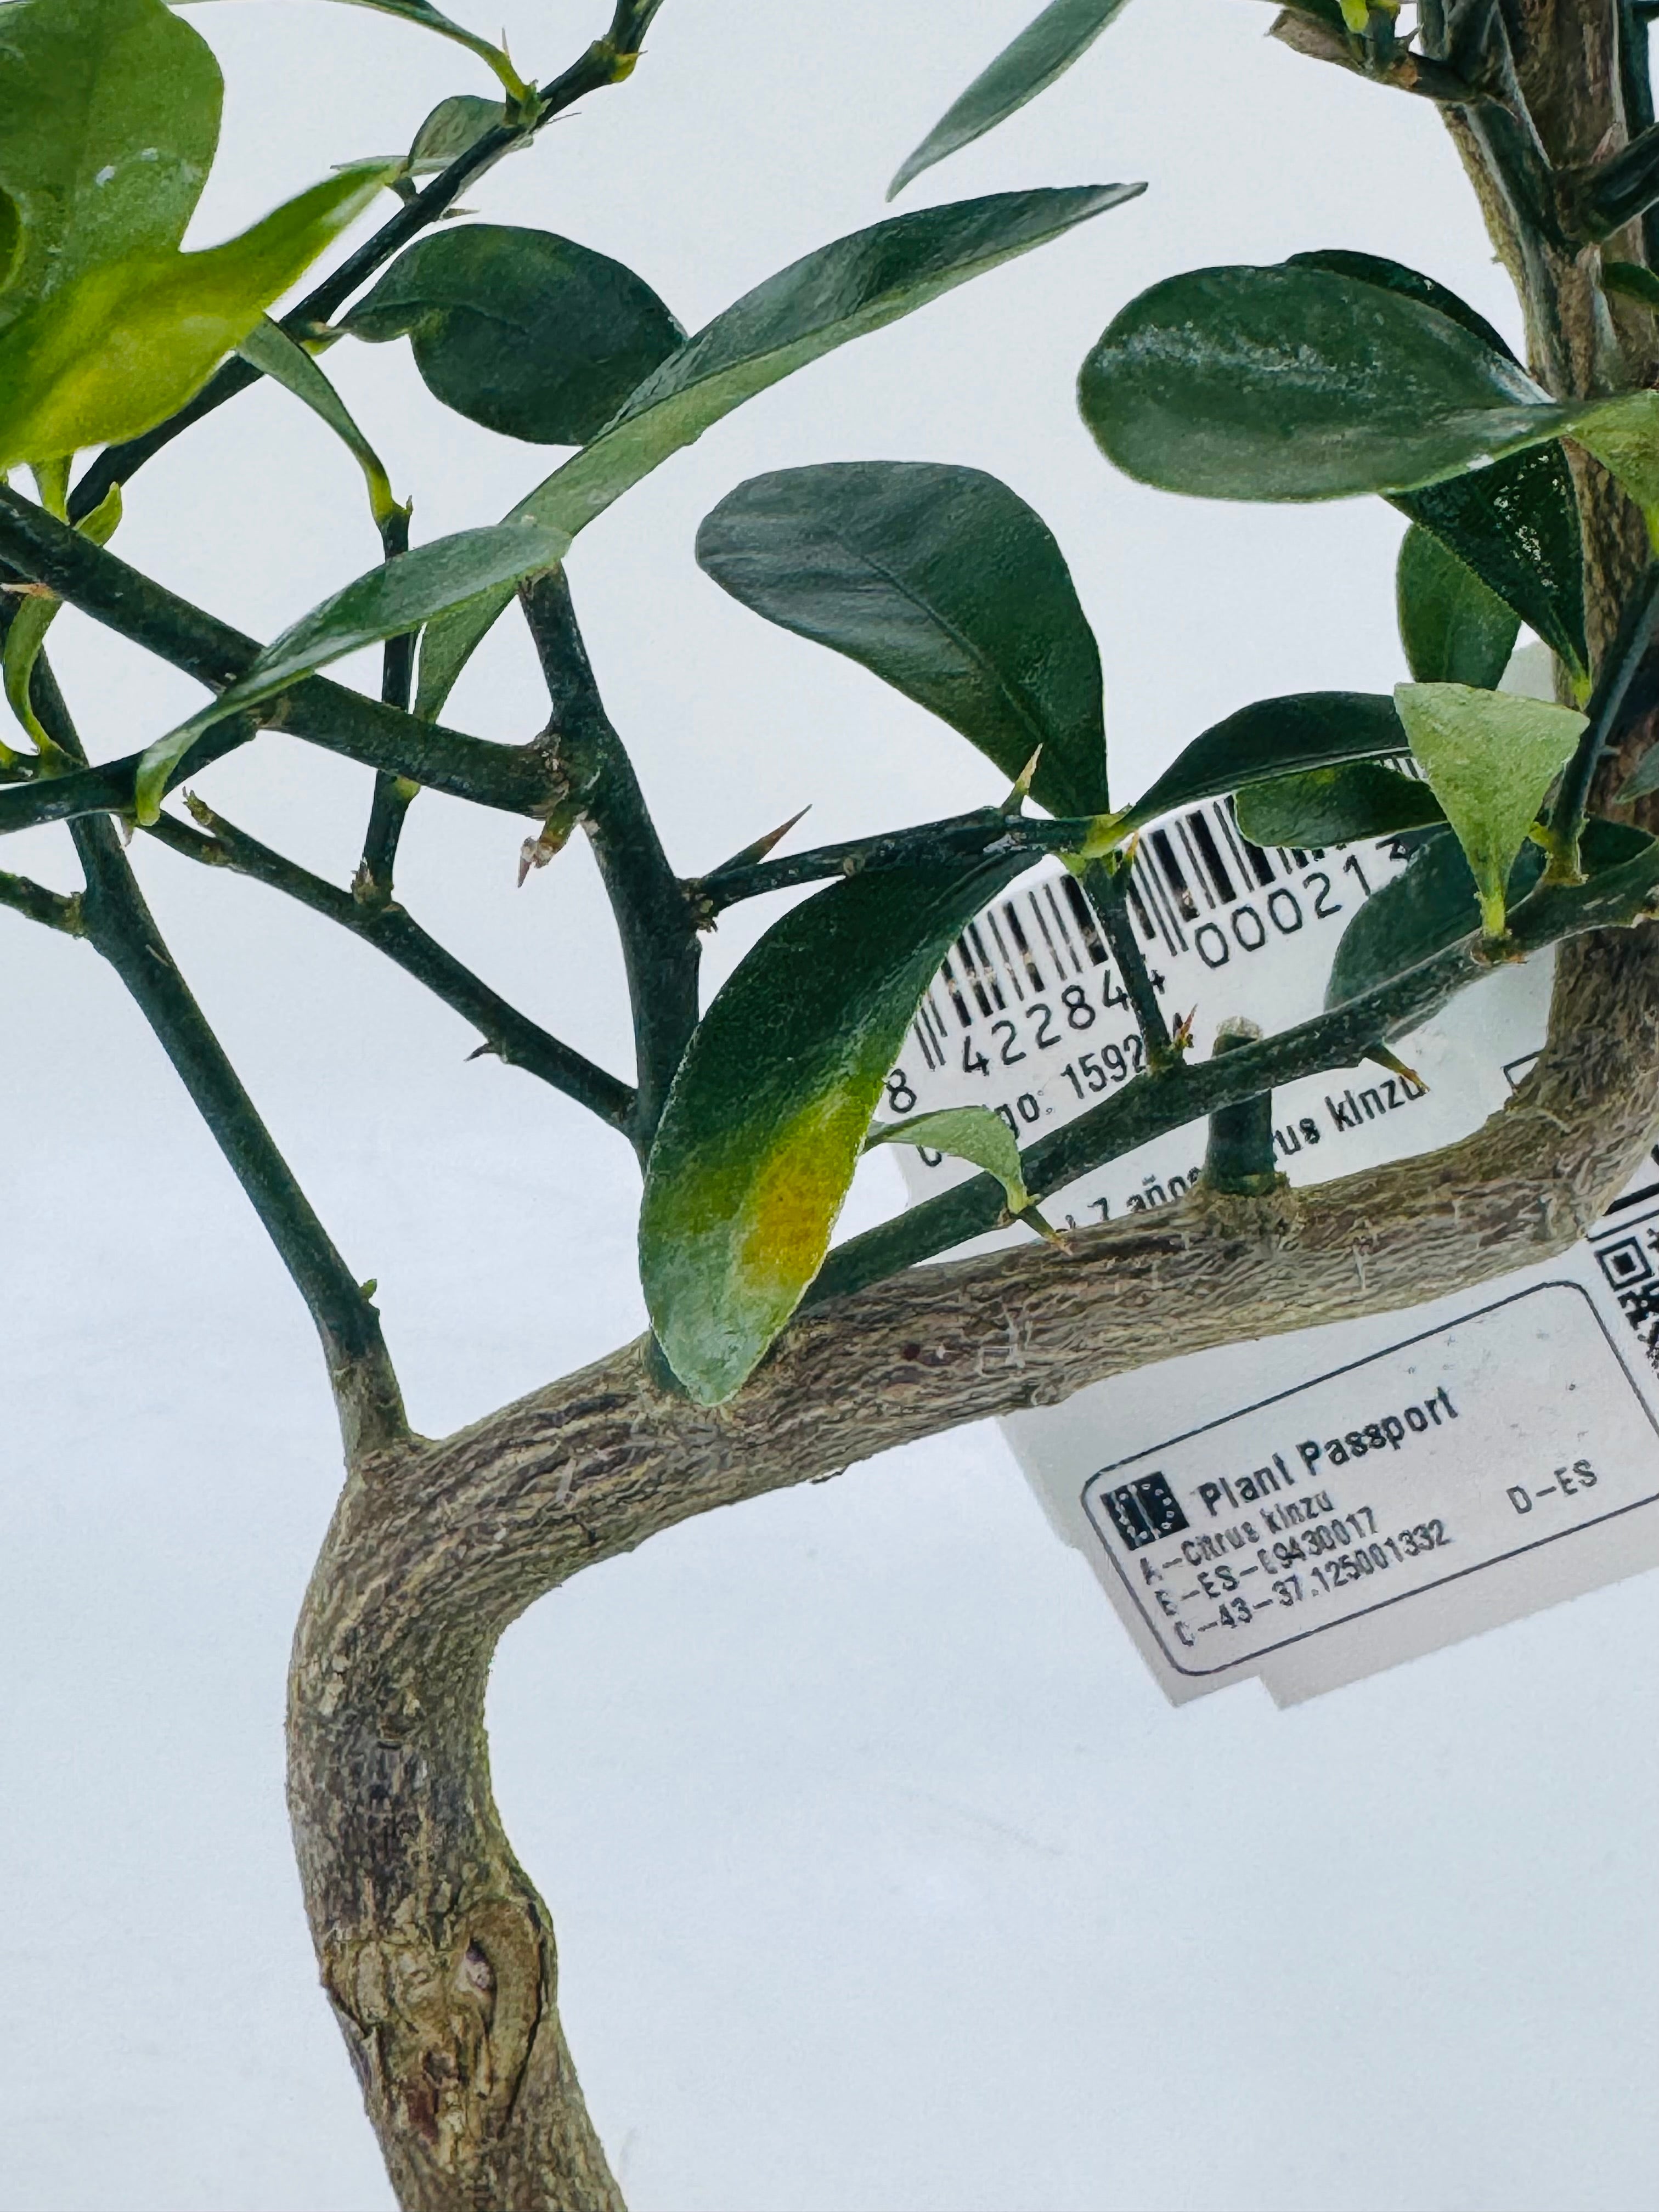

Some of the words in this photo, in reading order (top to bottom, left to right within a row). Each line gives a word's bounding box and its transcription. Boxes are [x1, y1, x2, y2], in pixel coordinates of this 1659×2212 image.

[886, 1068, 917, 1113] 8
[1198, 1452, 1295, 1517] Plant
[1296, 1386, 1459, 1476] Passport
[1506, 1459, 1597, 1514] D-ES
